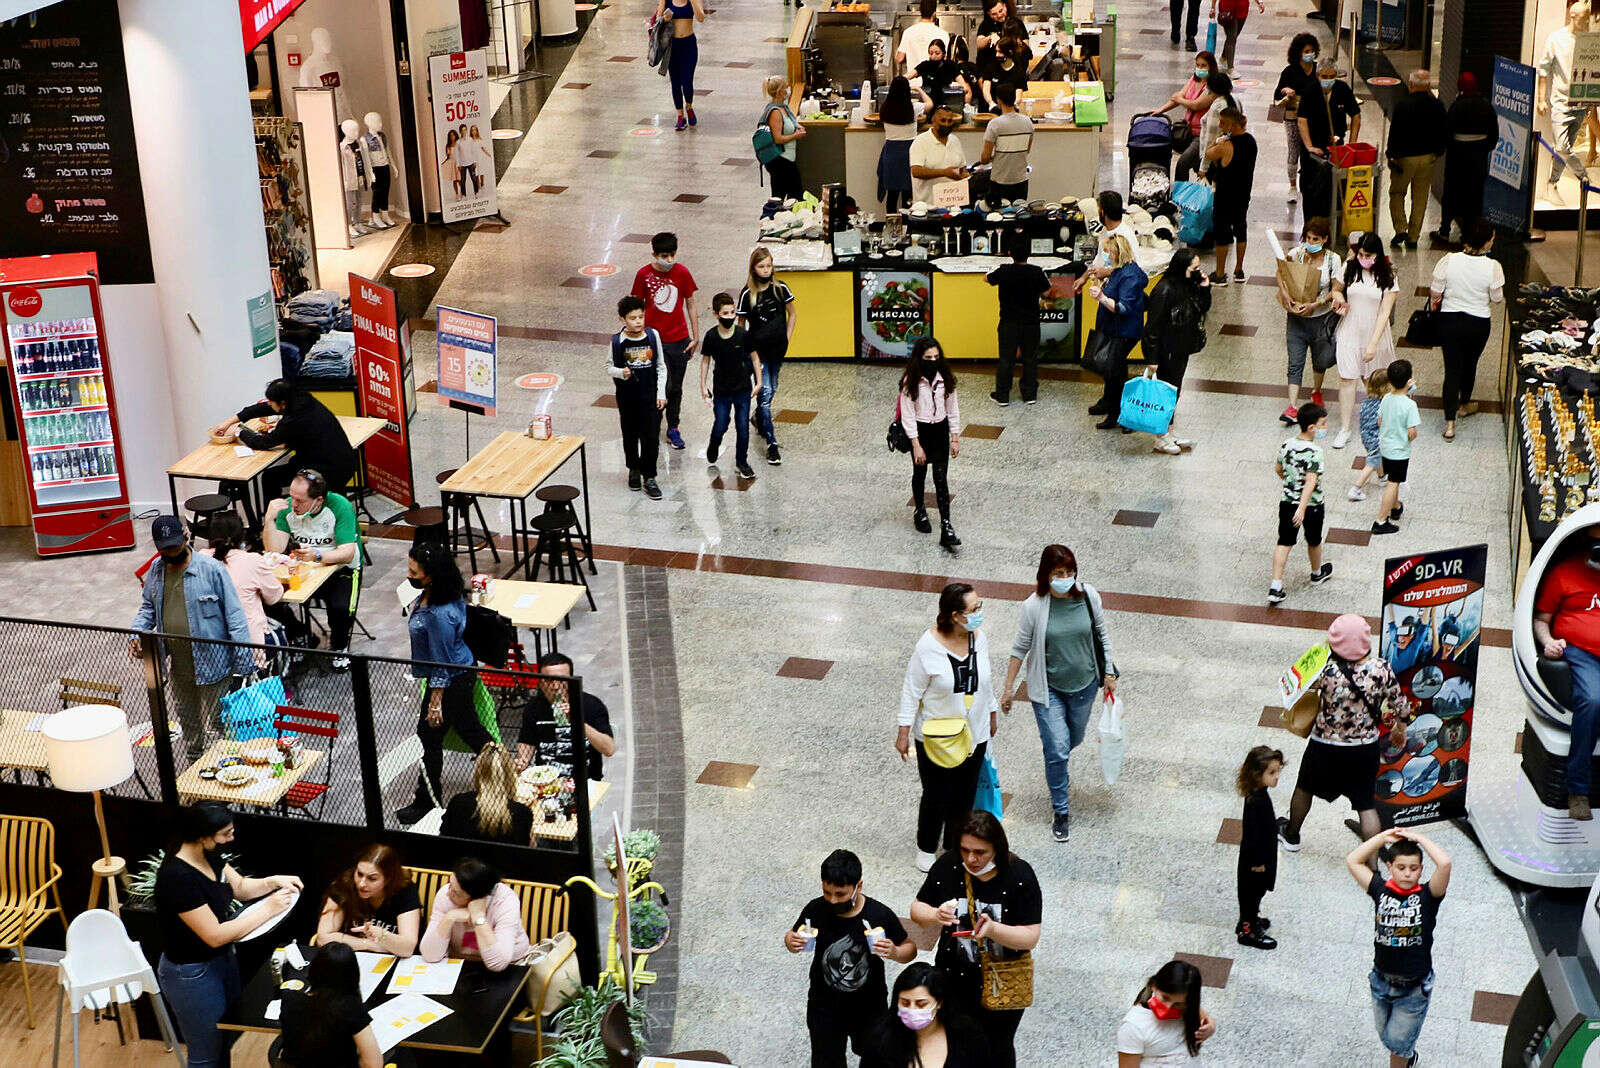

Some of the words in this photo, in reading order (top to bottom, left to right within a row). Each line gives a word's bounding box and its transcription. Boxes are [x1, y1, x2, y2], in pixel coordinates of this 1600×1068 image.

[442, 69, 477, 83] SUMMER
[1495, 83, 1511, 98] YOUR
[1512, 88, 1531, 103] VOICE
[445, 100, 479, 122] 50%
[1494, 95, 1529, 116] COUNTS!
[11, 296, 38, 308] Coca-Cola
[871, 311, 920, 319] MERCADO
[353, 313, 374, 334] FINAL
[375, 322, 396, 344] SALE!
[368, 362, 390, 383] 60%
[369, 380, 391, 399] הנחה
[1127, 397, 1165, 413] URBANICA
[291, 532, 333, 545] VOLVO
[1415, 559, 1463, 581] 9D-VR
[1403, 590, 1425, 603] שלנו
[1425, 583, 1468, 599] המומלצים
